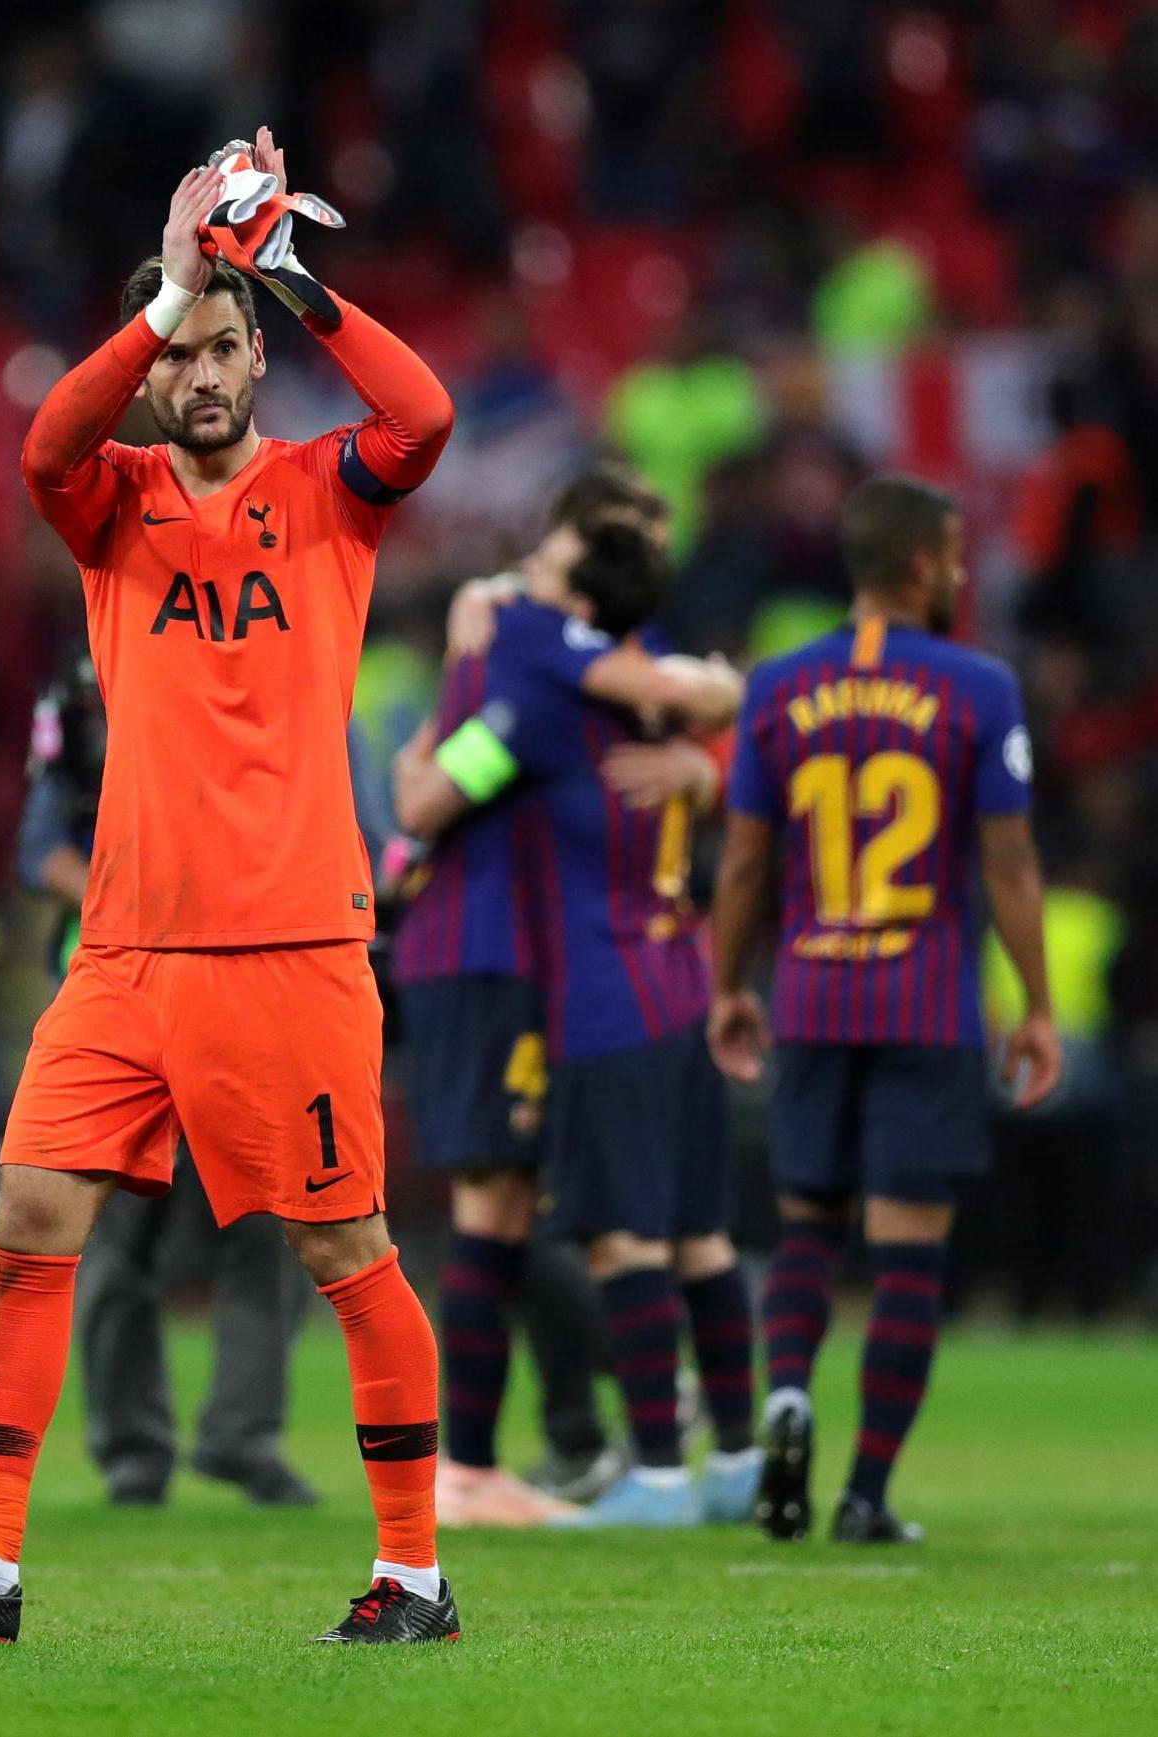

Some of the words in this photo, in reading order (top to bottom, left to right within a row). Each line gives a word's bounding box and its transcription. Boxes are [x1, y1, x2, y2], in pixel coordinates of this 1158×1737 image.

[150, 570, 290, 641] AIA
[792, 752, 940, 925] 12
[305, 1093, 339, 1169] 1
